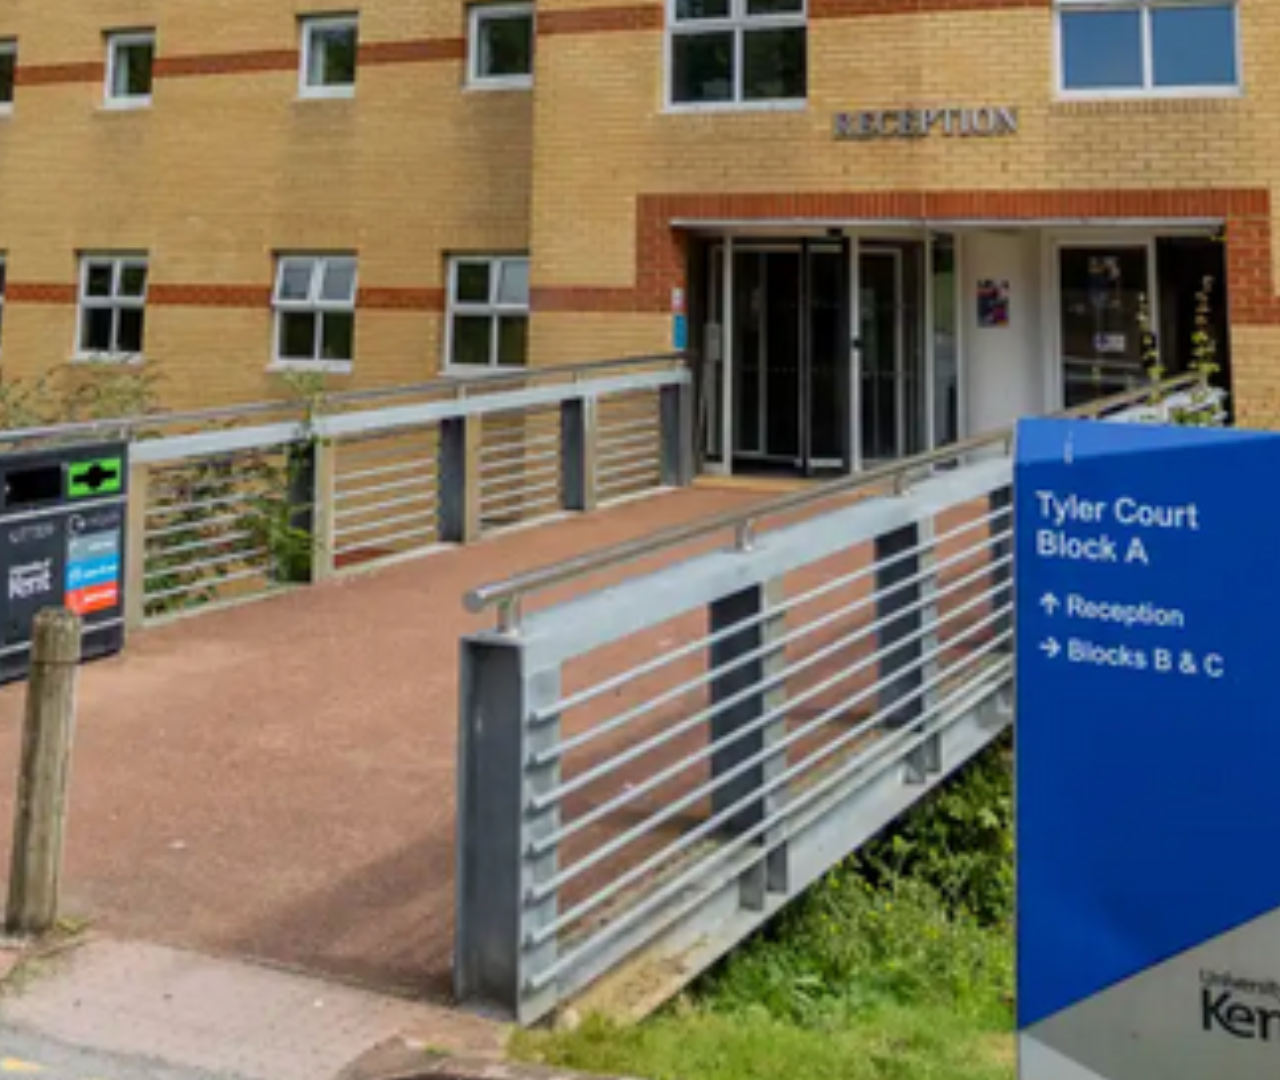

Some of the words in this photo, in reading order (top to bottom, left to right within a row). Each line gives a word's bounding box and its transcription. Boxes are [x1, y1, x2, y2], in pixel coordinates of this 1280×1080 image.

[833, 107, 1017, 140] RECEPTION
[1035, 490, 1107, 527] Tyler
[1114, 496, 1200, 530] Court
[1036, 529, 1117, 562] Block
[1124, 536, 1149, 565] A
[1067, 593, 1185, 628] Reception
[1067, 637, 1148, 669] Blocks
[1154, 647, 1172, 671] B
[1179, 650, 1197, 674] &
[1204, 652, 1224, 678] C
